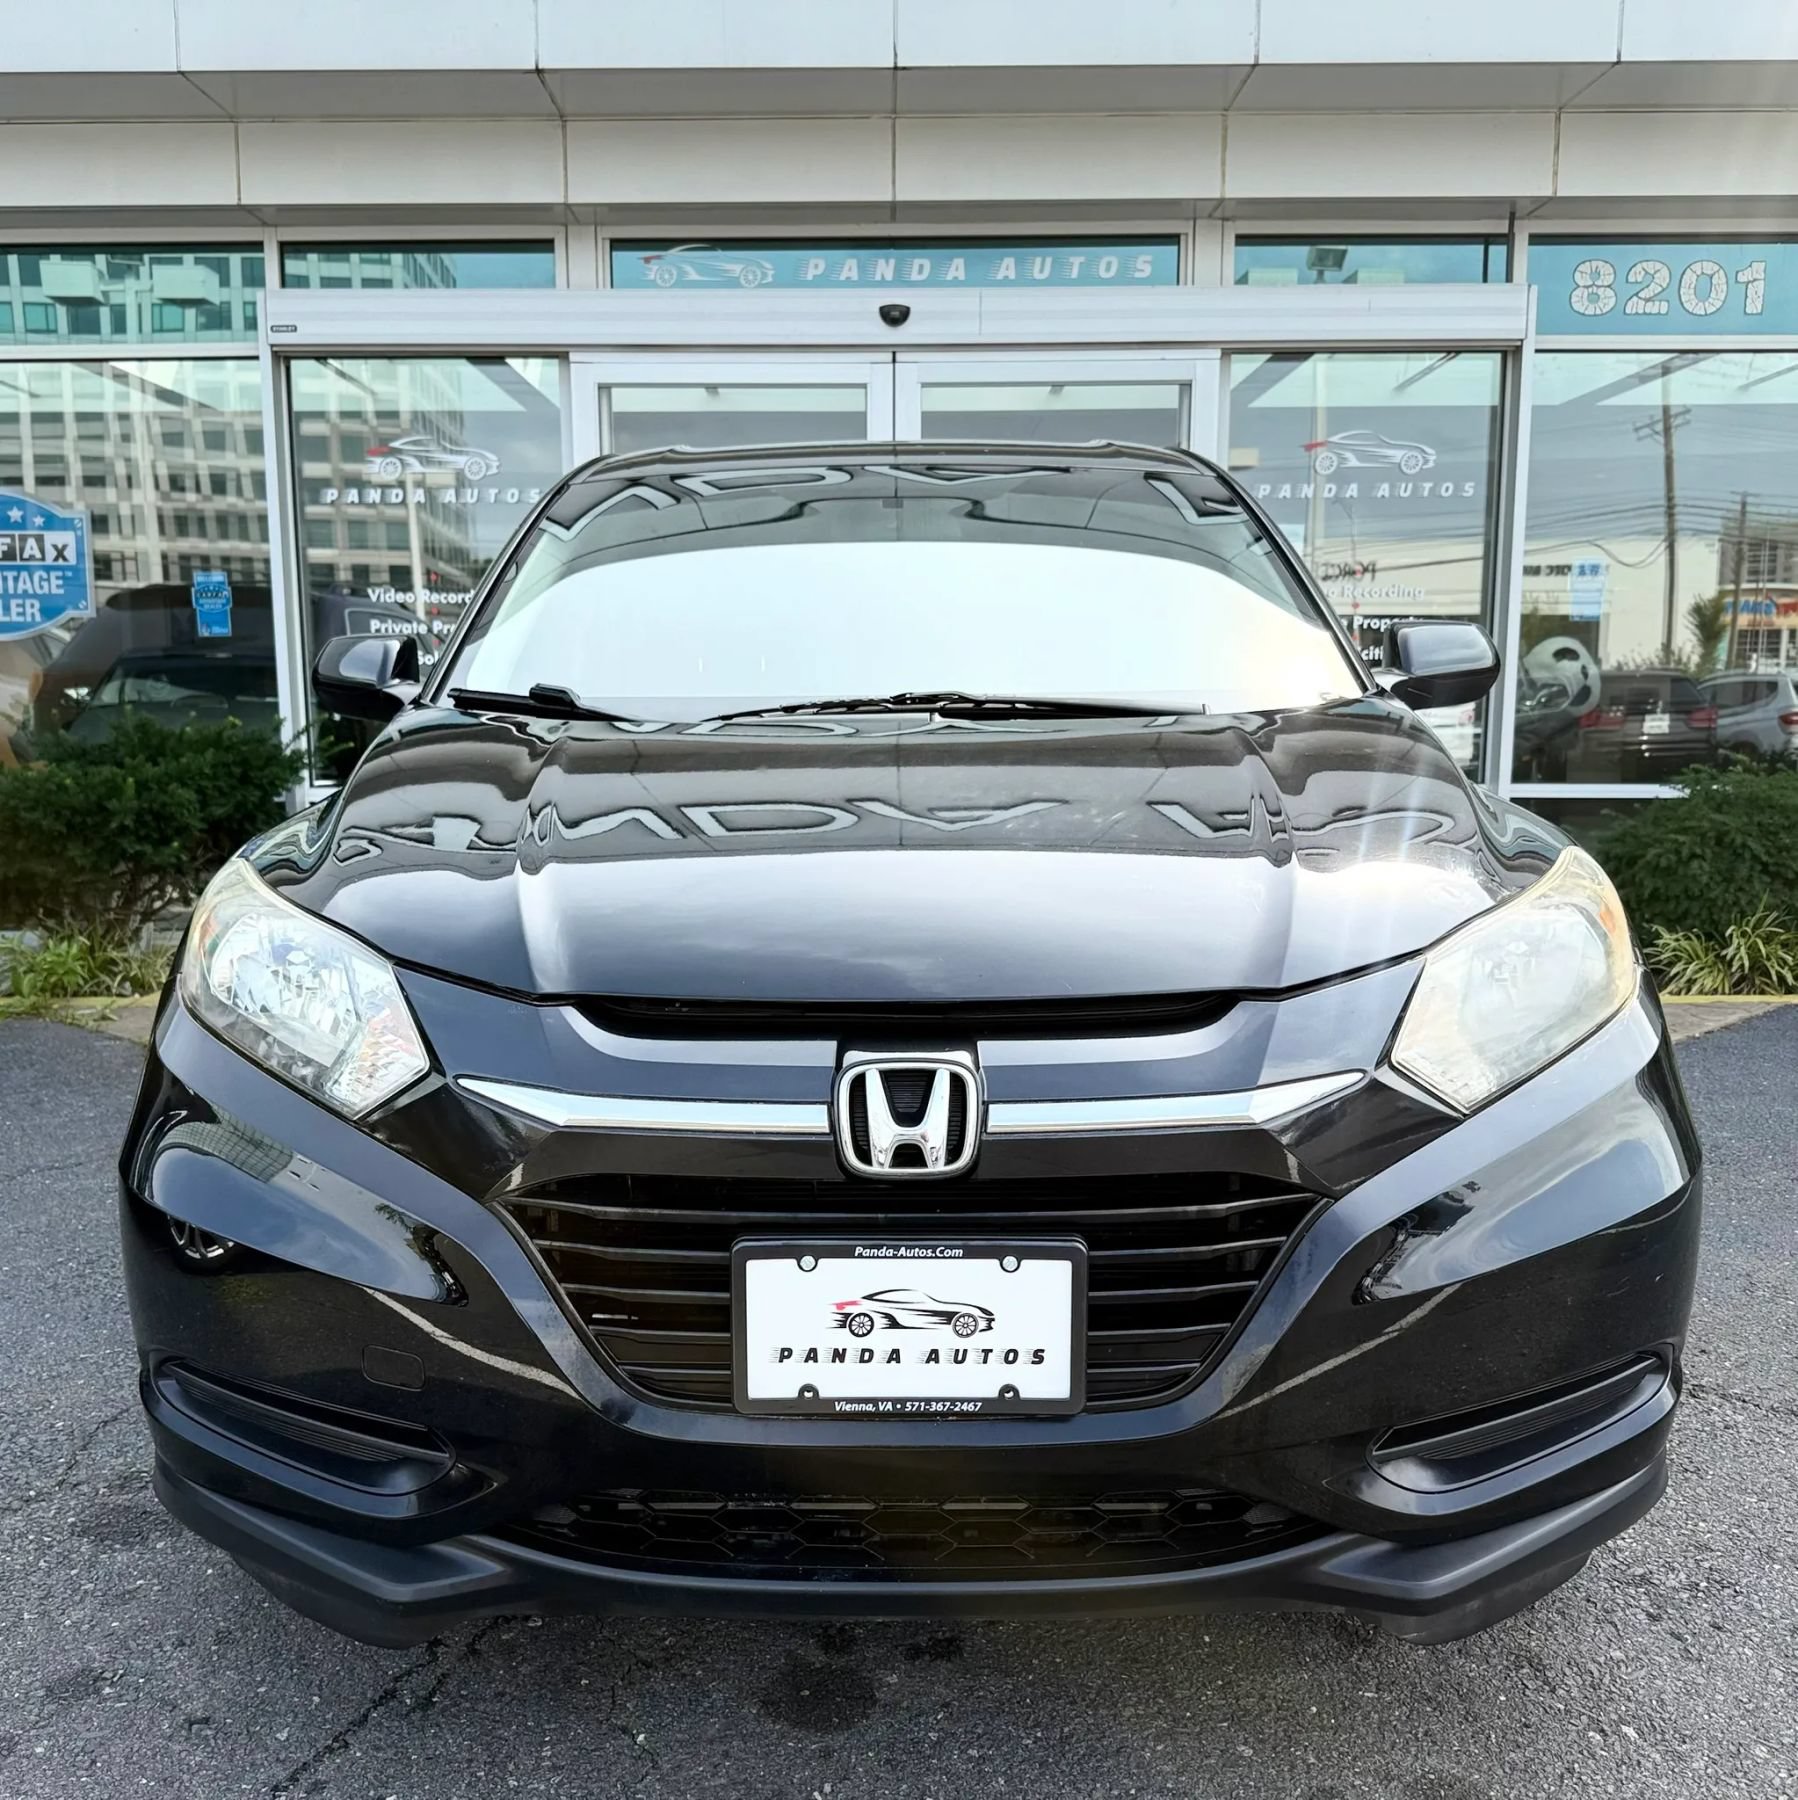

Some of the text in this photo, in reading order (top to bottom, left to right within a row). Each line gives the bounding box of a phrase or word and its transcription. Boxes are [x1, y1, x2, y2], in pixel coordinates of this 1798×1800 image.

[802, 255, 1153, 281] PANDA AUTOS
[1569, 259, 1767, 317] 8201
[325, 487, 541, 504] PANDA AUTOS
[1257, 481, 1475, 499] PANDA AUTOS
[367, 588, 415, 605] Video
[1343, 584, 1425, 601] Recording
[370, 618, 429, 635] Private
[854, 1245, 964, 1258] Panda-Autos.Com
[777, 1347, 1046, 1365] PANDA AUTOS
[834, 1401, 983, 1413] Vienna, VA 571-367-2467
